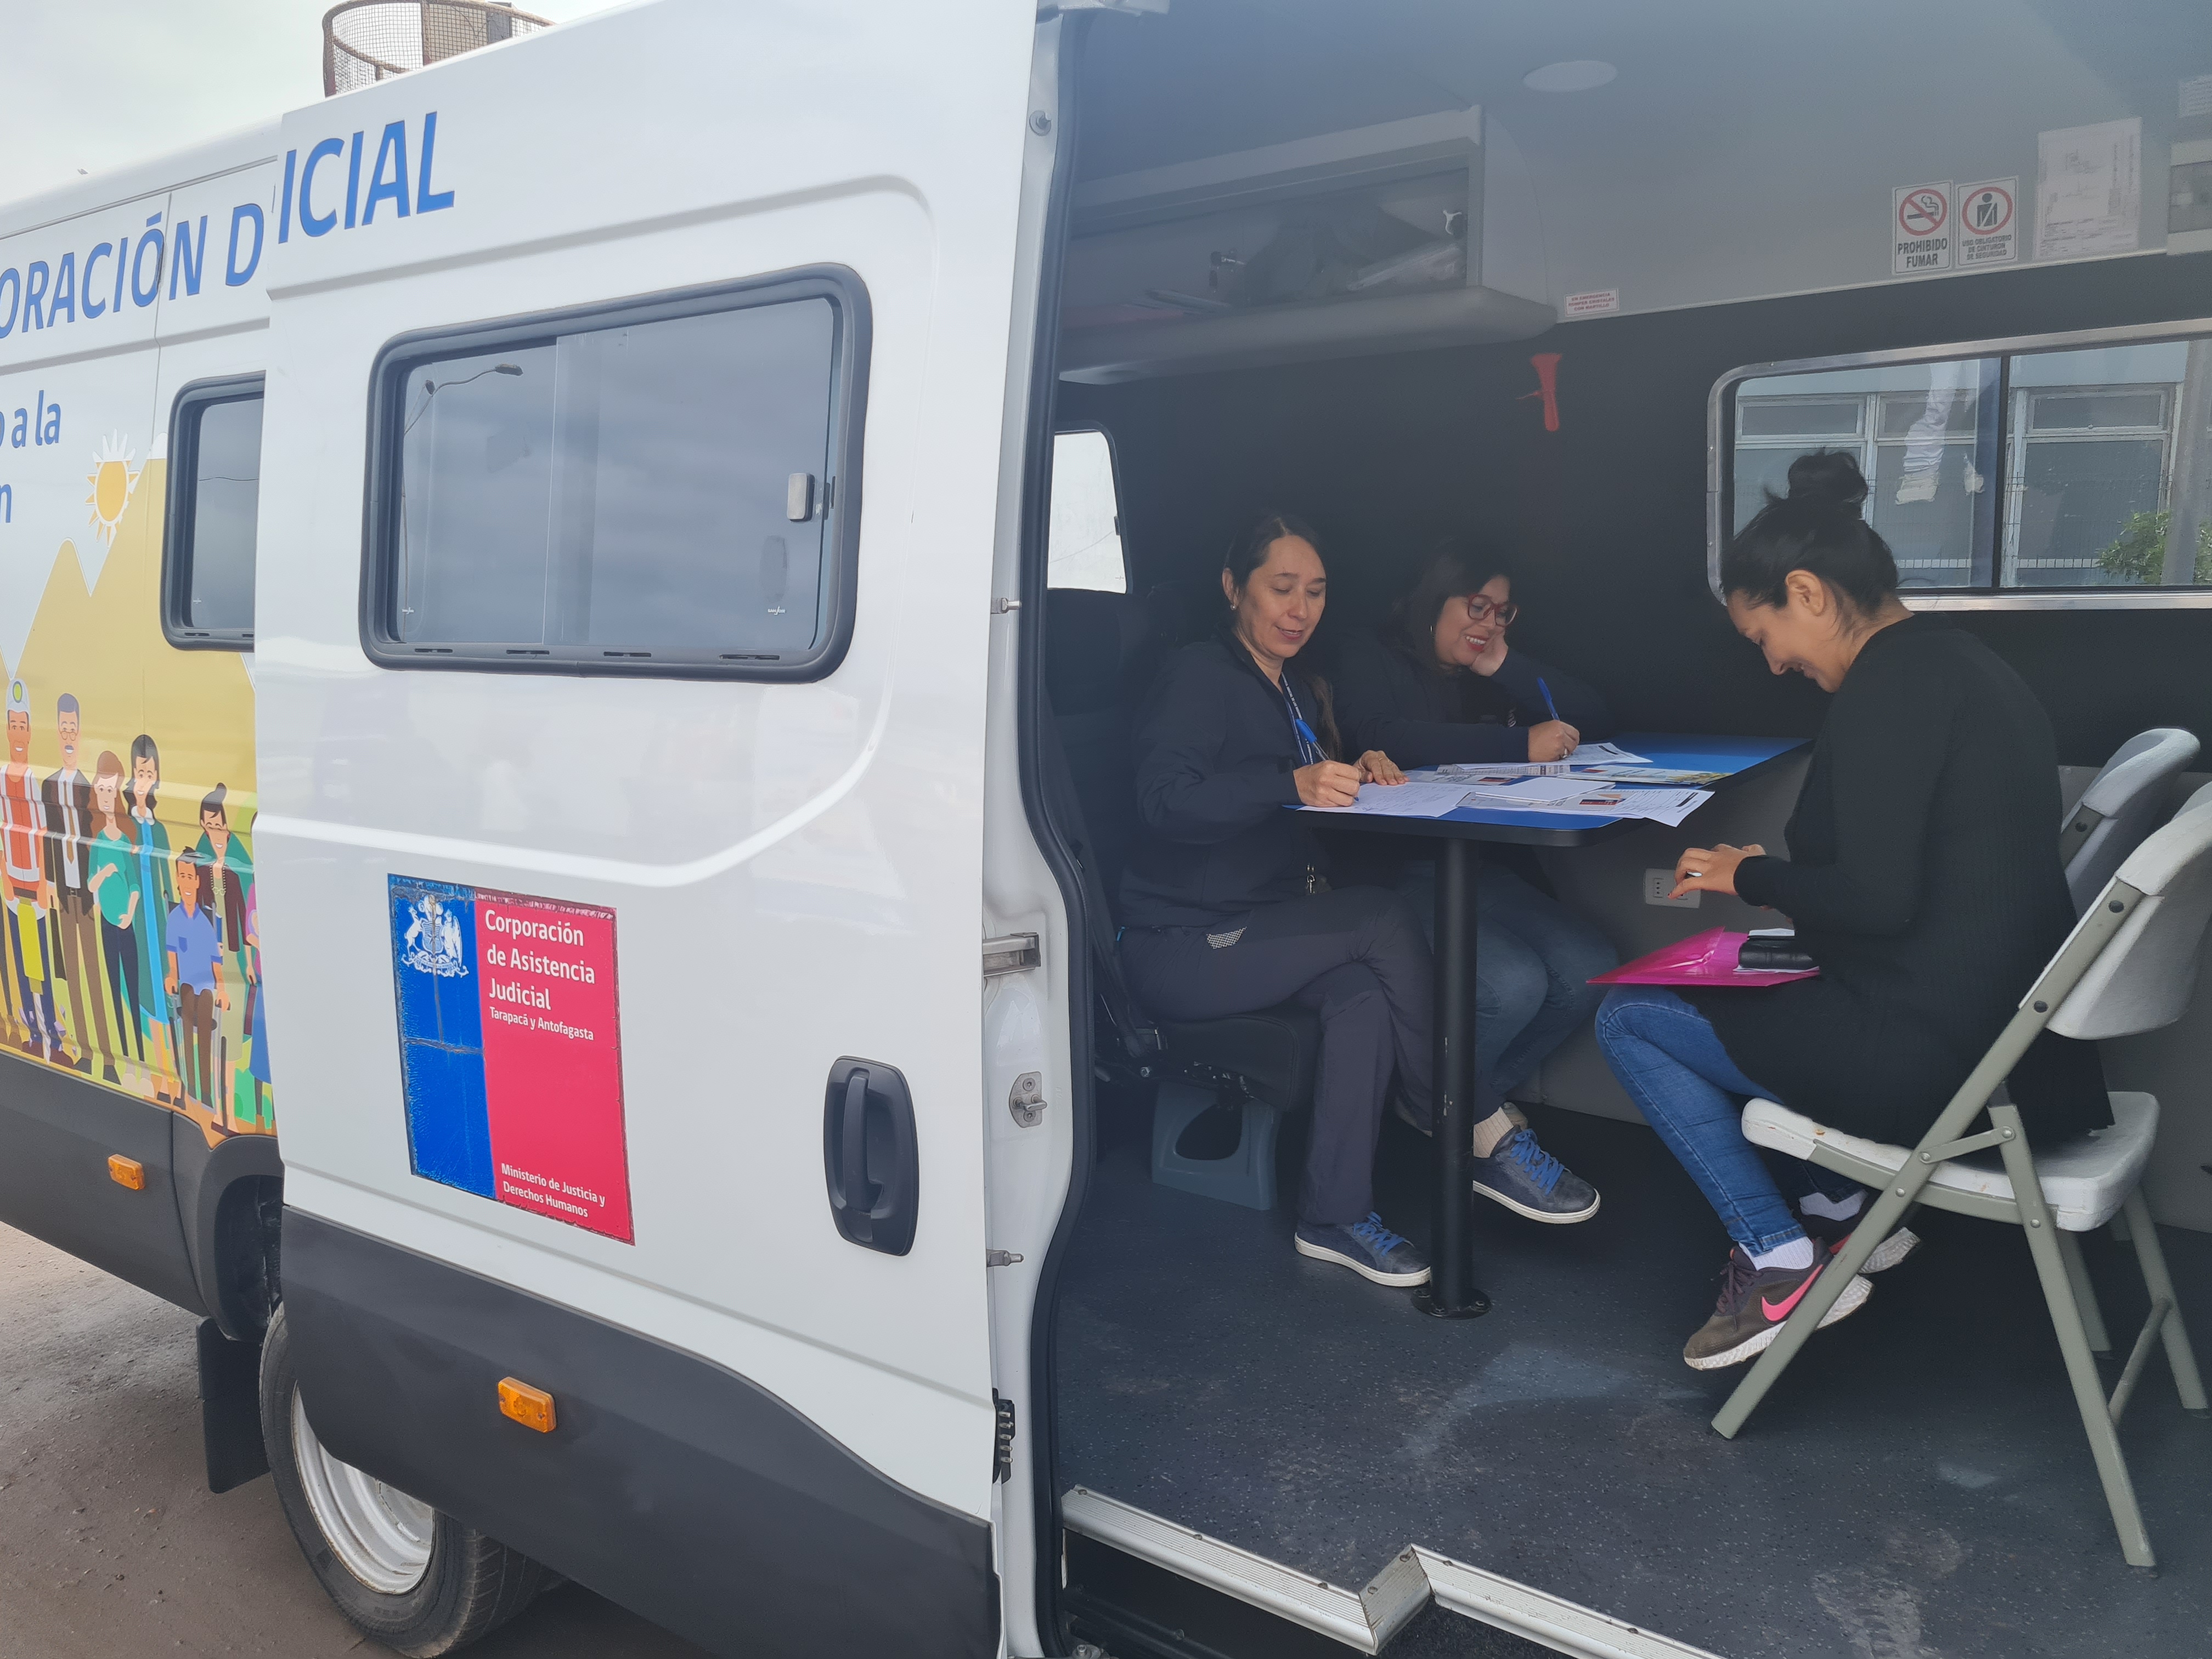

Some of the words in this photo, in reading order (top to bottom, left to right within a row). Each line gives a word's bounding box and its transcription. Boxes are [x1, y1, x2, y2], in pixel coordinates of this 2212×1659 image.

[1898, 238, 1948, 255] PROHIBIDO
[1975, 234, 2012, 245] OBLIGATORIO
[1976, 249, 2007, 259] SEGURIDAD
[1906, 253, 1938, 268] FUMAR
[12, 408, 28, 449] a
[35, 390, 61, 446] la
[485, 909, 584, 946] Corporación
[487, 943, 506, 967] de
[510, 947, 595, 985] Asistencia
[488, 977, 551, 1011] Judicial
[489, 1006, 529, 1025] Tarapacá
[529, 1017, 537, 1031] y
[537, 1017, 594, 1041] Antofagasta
[501, 1163, 548, 1187] Ministerio
[548, 1177, 560, 1192] de
[561, 1181, 598, 1204] Justicia
[598, 1195, 606, 1208] y
[503, 1180, 545, 1203] Derechos
[544, 1193, 589, 1218] Humanos
